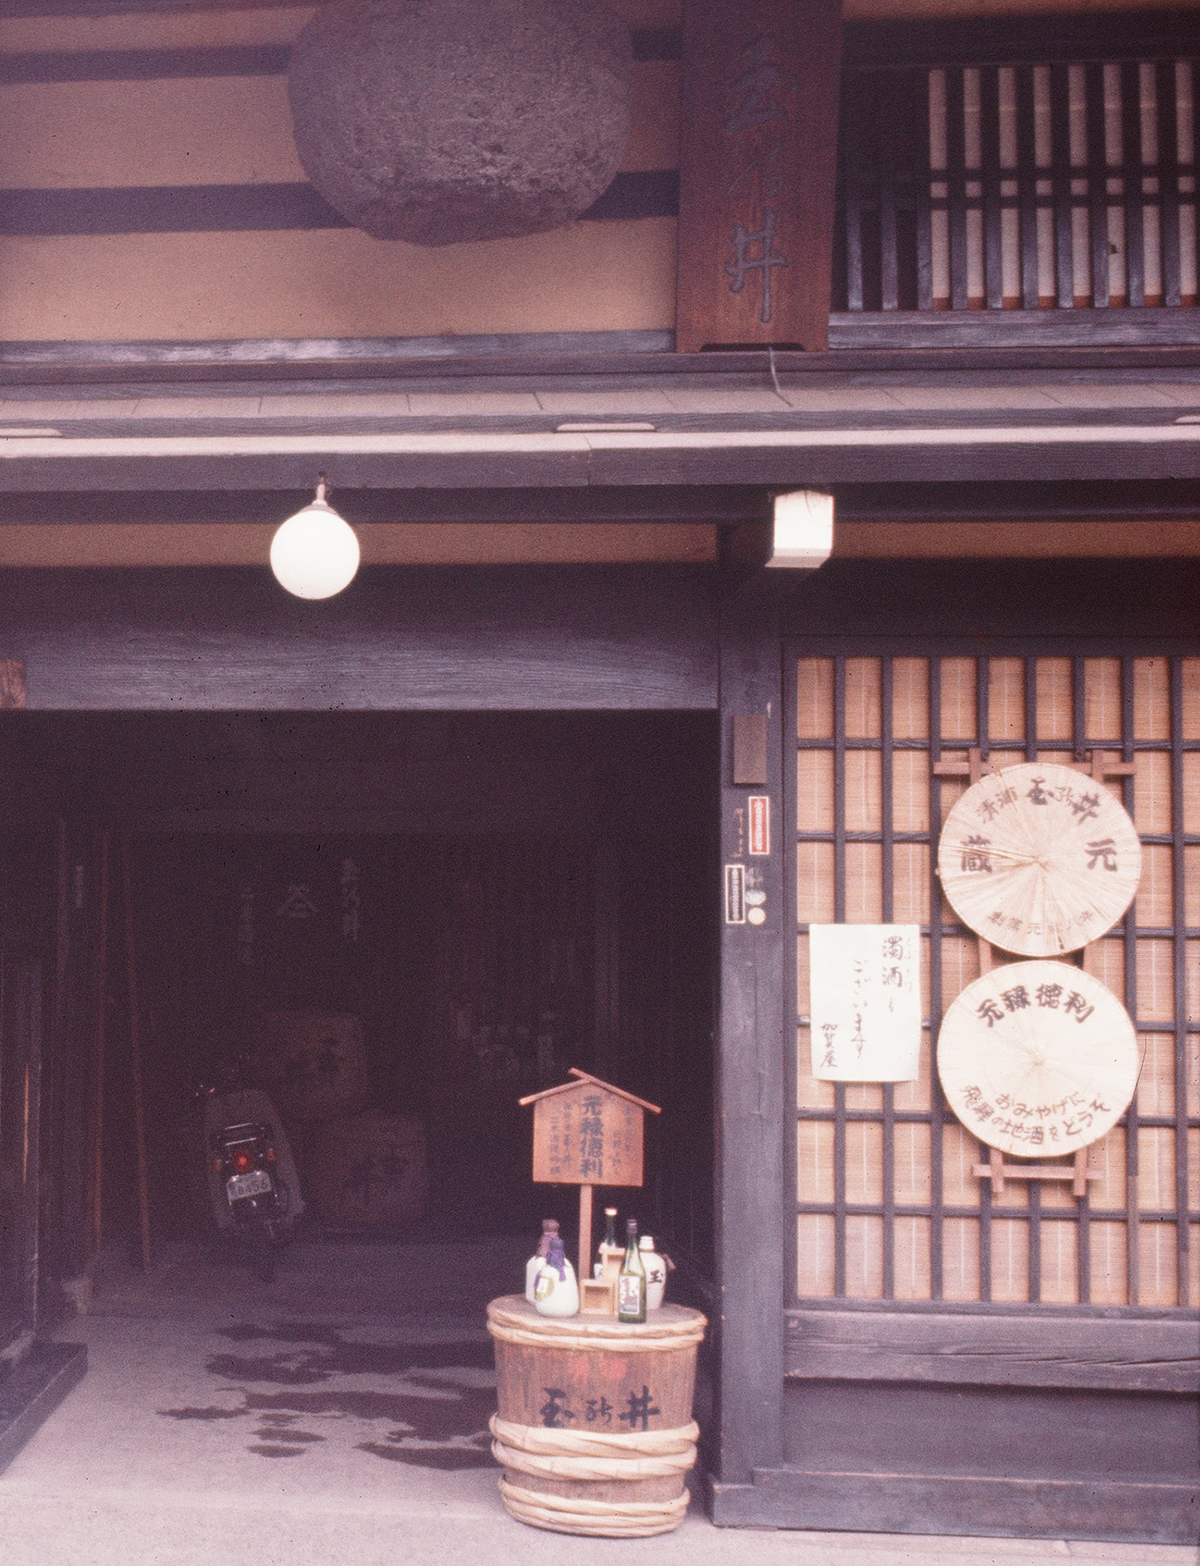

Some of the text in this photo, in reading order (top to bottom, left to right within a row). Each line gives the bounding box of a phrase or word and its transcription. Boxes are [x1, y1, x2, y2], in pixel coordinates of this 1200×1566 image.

[995, 1091, 1086, 1119] おみやげに
